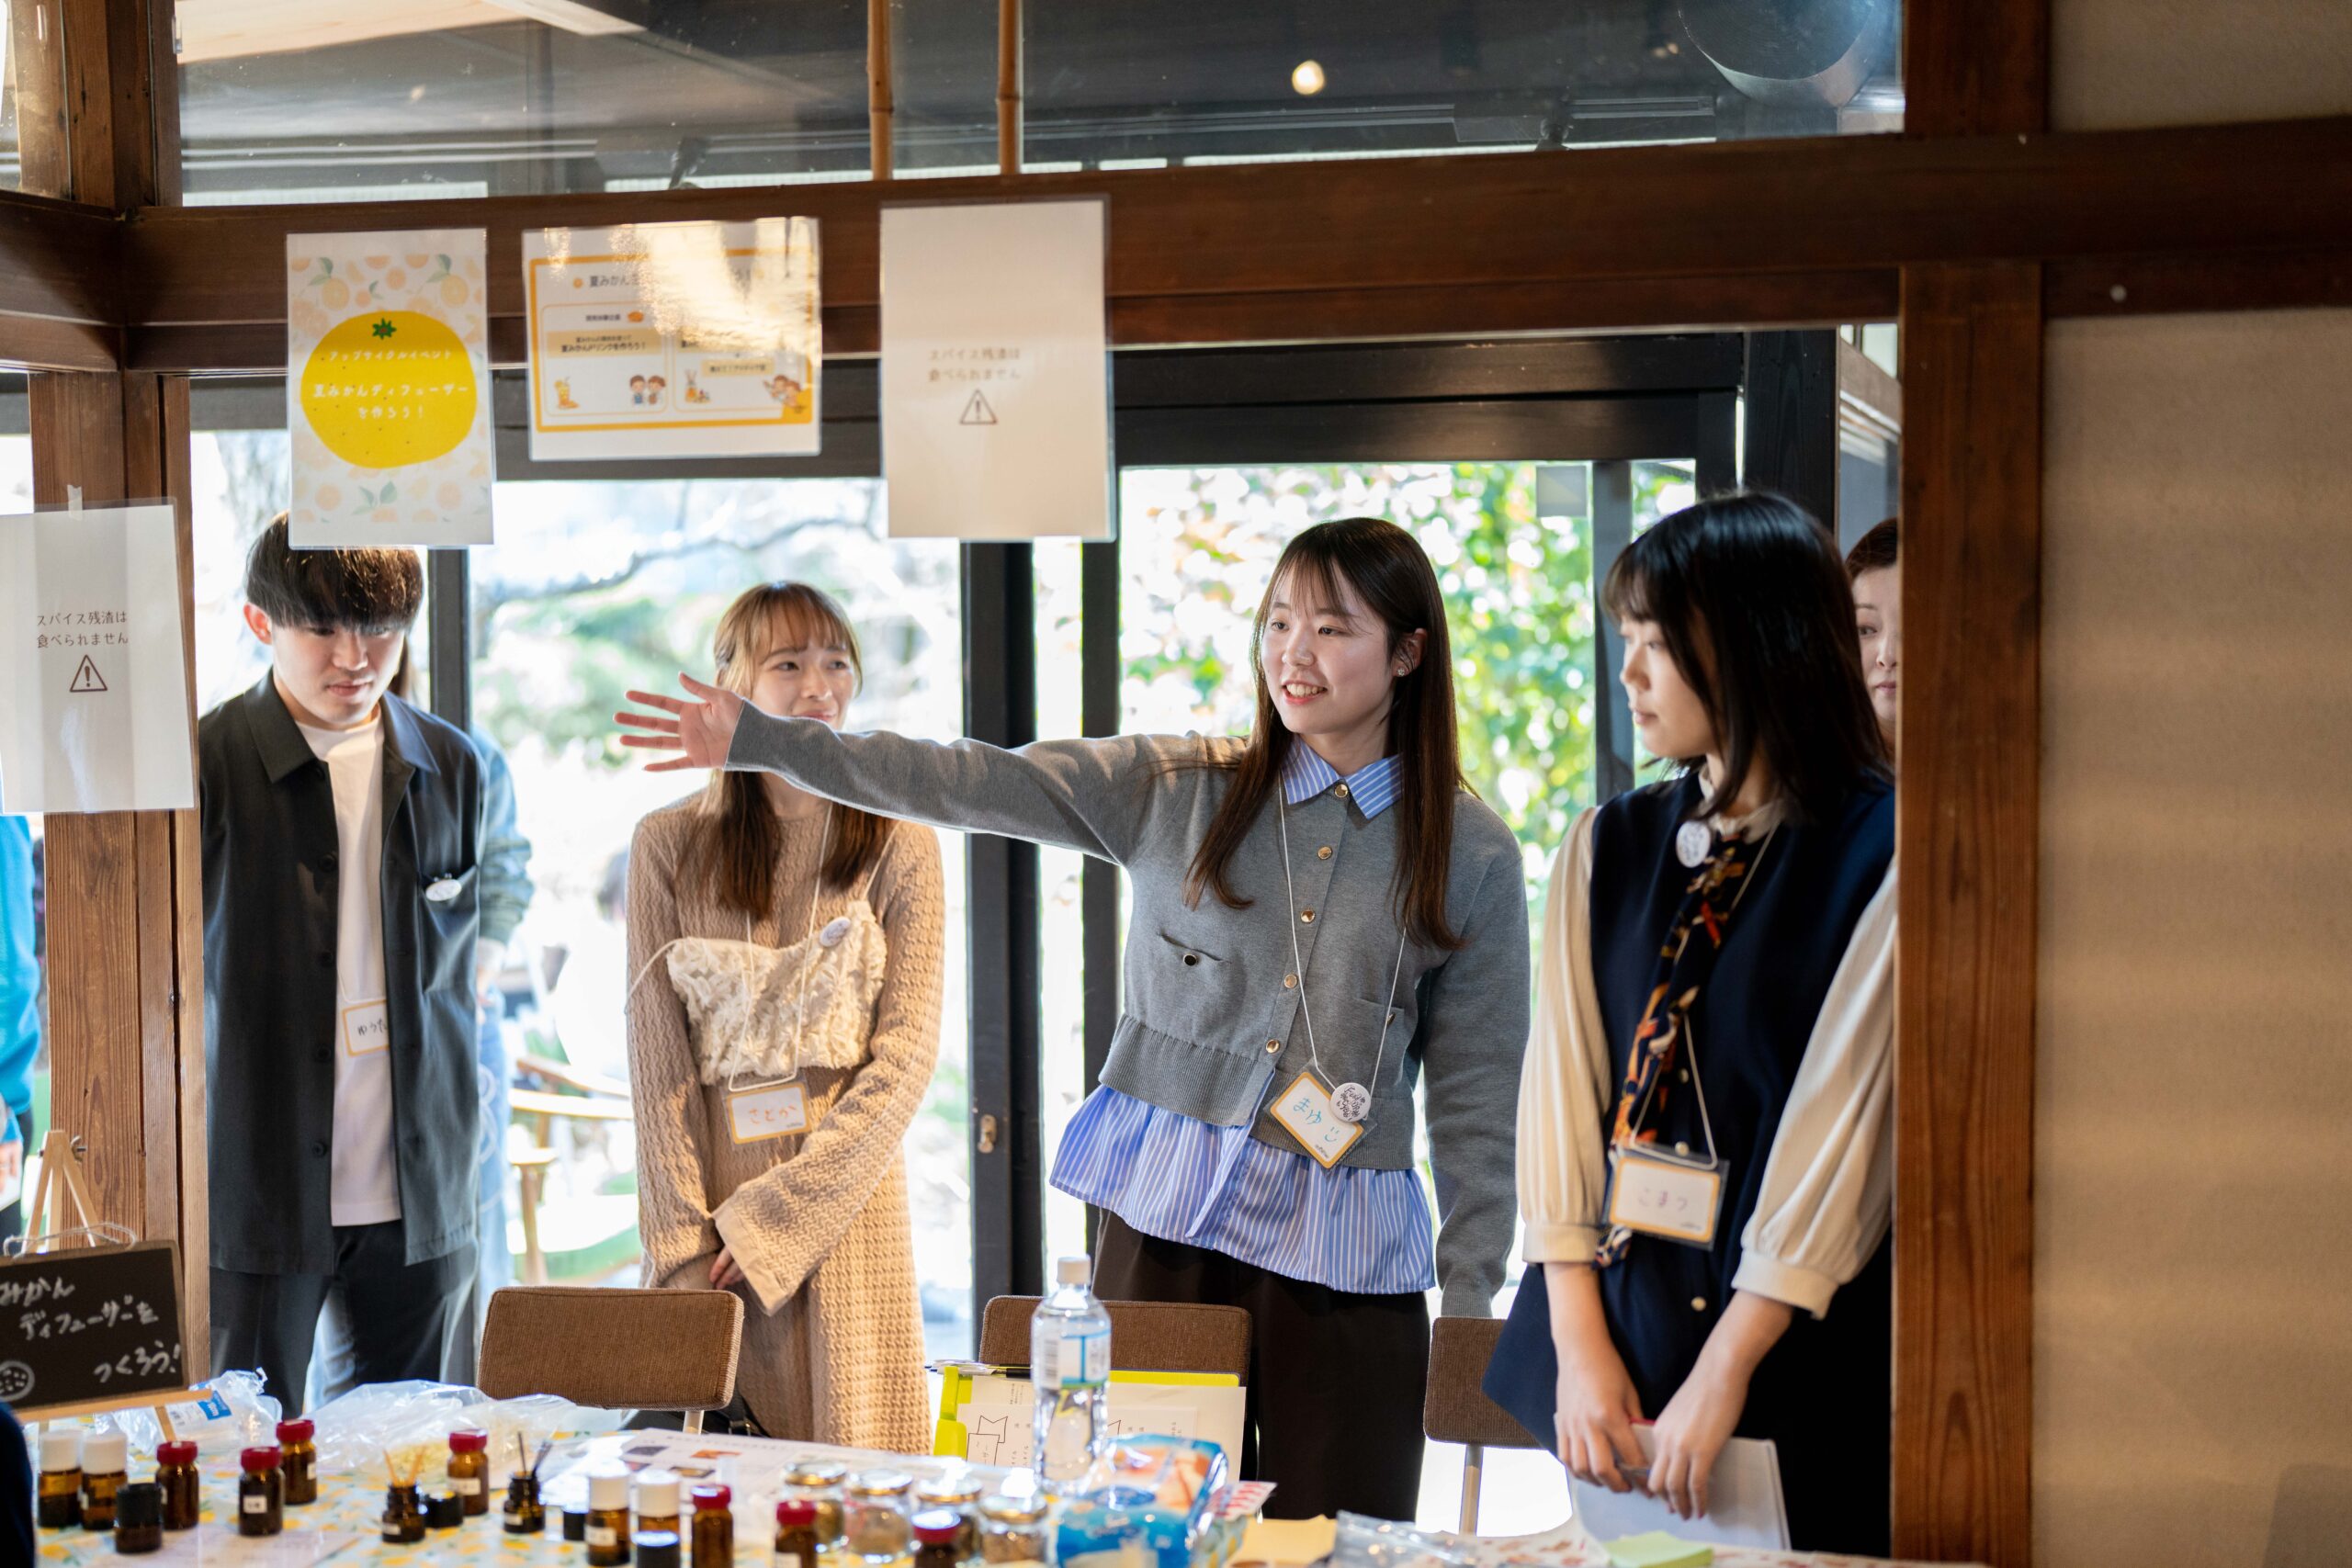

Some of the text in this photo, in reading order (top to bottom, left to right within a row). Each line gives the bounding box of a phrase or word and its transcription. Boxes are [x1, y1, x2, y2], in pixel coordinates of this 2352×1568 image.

[329, 349, 452, 362] アップサイクルイベント
[928, 368, 1021, 382] 食べられません
[313, 383, 468, 398] 夏みかんディフューザー
[37, 610, 127, 626] スパイス残渣は
[37, 632, 128, 649] 食べられません
